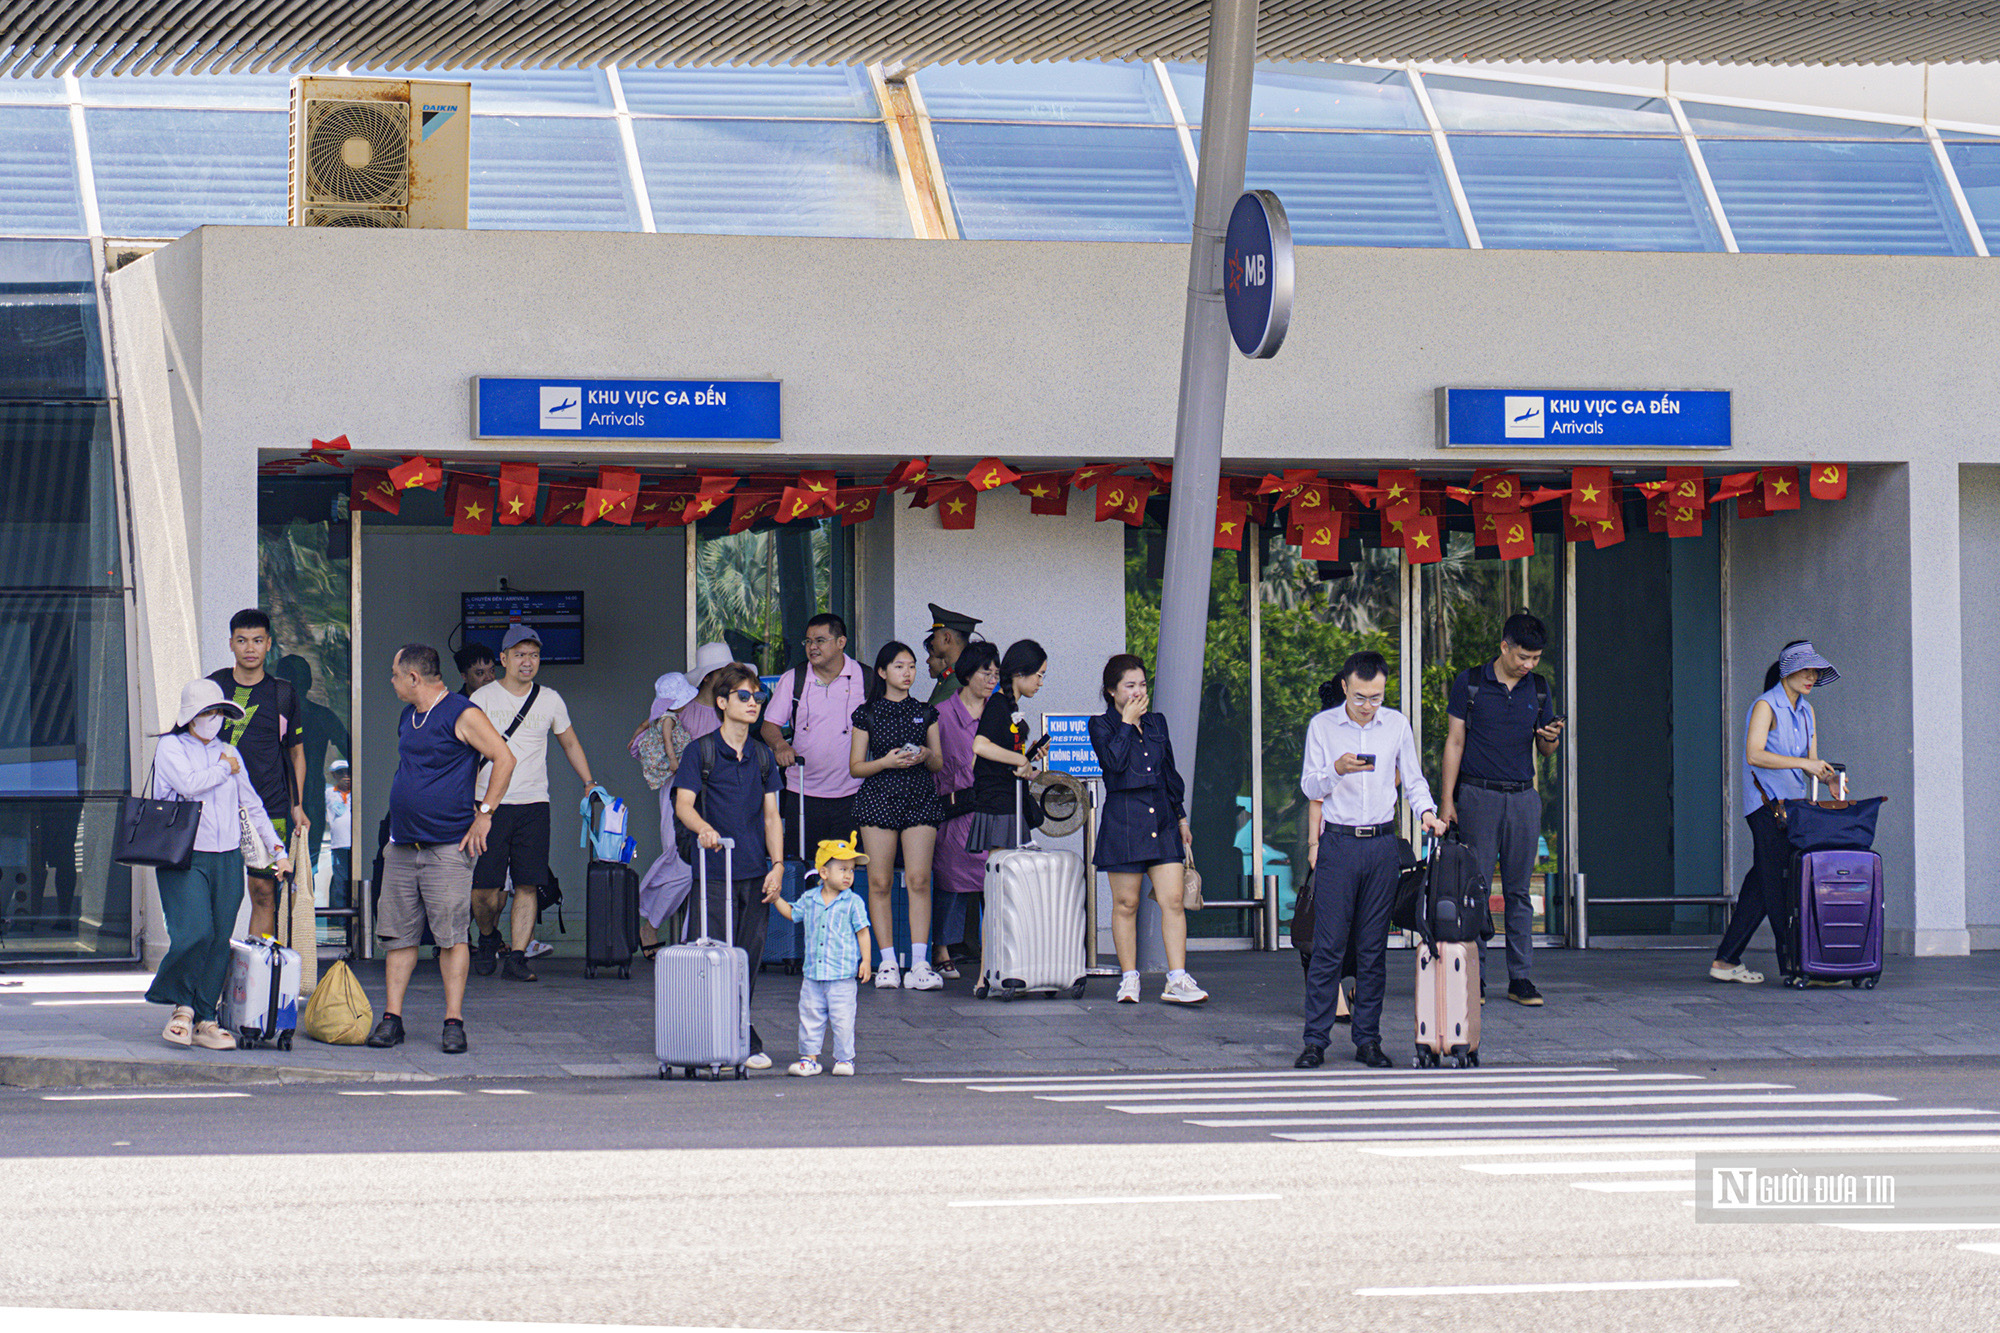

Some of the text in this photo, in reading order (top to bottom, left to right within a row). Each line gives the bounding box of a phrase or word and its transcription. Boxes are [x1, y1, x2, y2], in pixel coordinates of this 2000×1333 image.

[422, 104, 458, 112] DAIKIN
[1245, 253, 1266, 287] MB
[588, 384, 727, 409] KHU VỰC GA ĐẾN
[1550, 394, 1680, 417] KHU VỰC GA ĐẾN
[589, 411, 645, 427] Arrivals
[1551, 419, 1604, 435] Arrivals
[1050, 719, 1087, 734] KHU VỰC
[1050, 749, 1071, 762] KHÔNG
[1072, 749, 1089, 763] PHẬN
